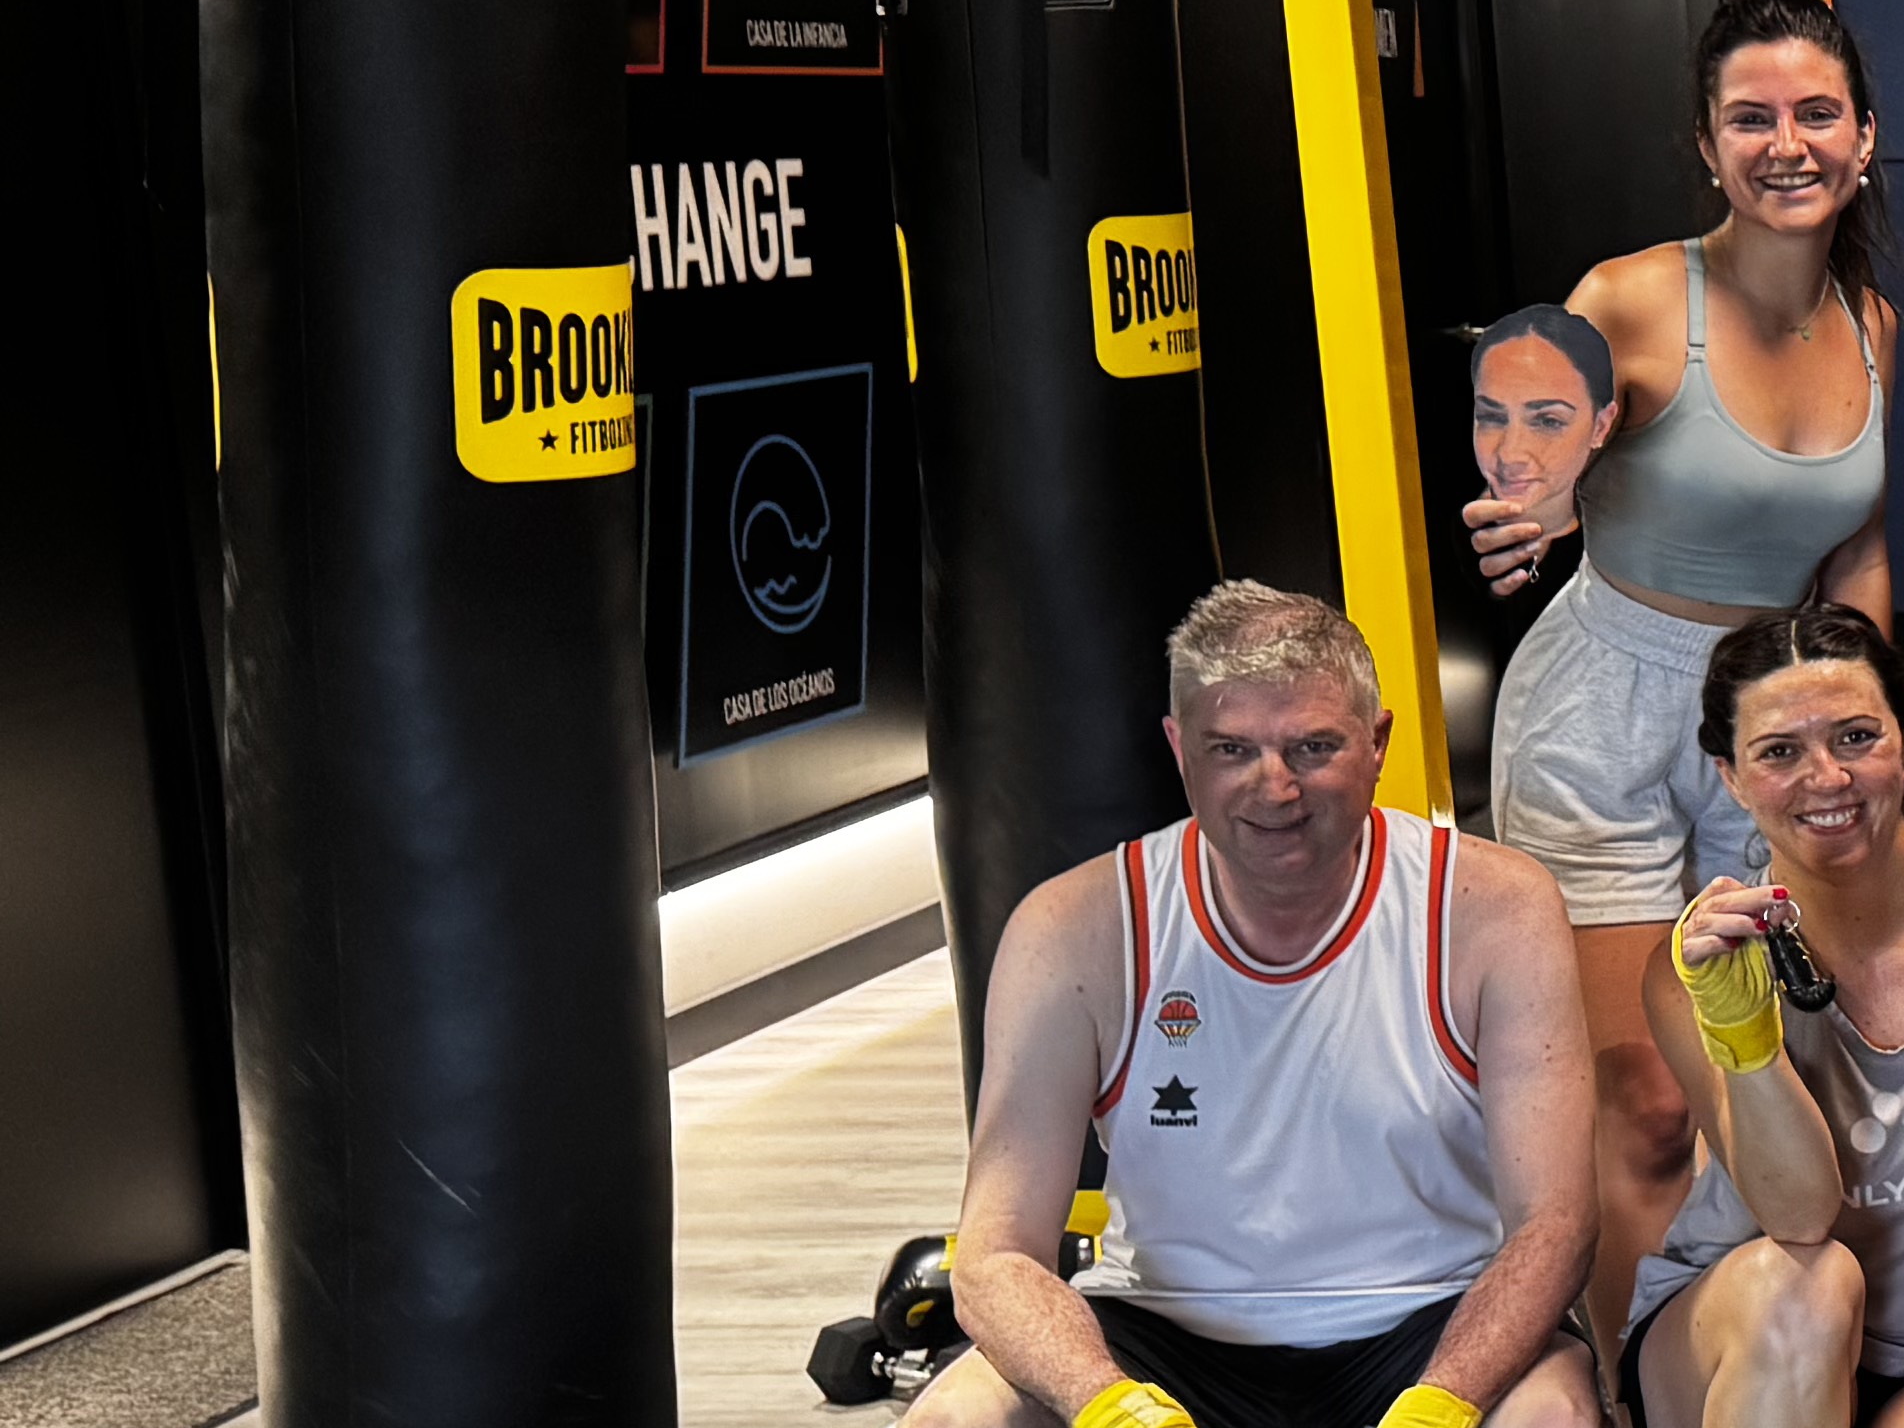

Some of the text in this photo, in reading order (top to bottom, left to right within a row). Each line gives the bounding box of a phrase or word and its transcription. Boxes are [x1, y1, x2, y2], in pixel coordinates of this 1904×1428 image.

[746, 19, 774, 47] CASA
[630, 157, 813, 292] HANGE
[723, 693, 753, 725] CASA
[752, 687, 768, 717] DE
[767, 681, 789, 712] LOS
